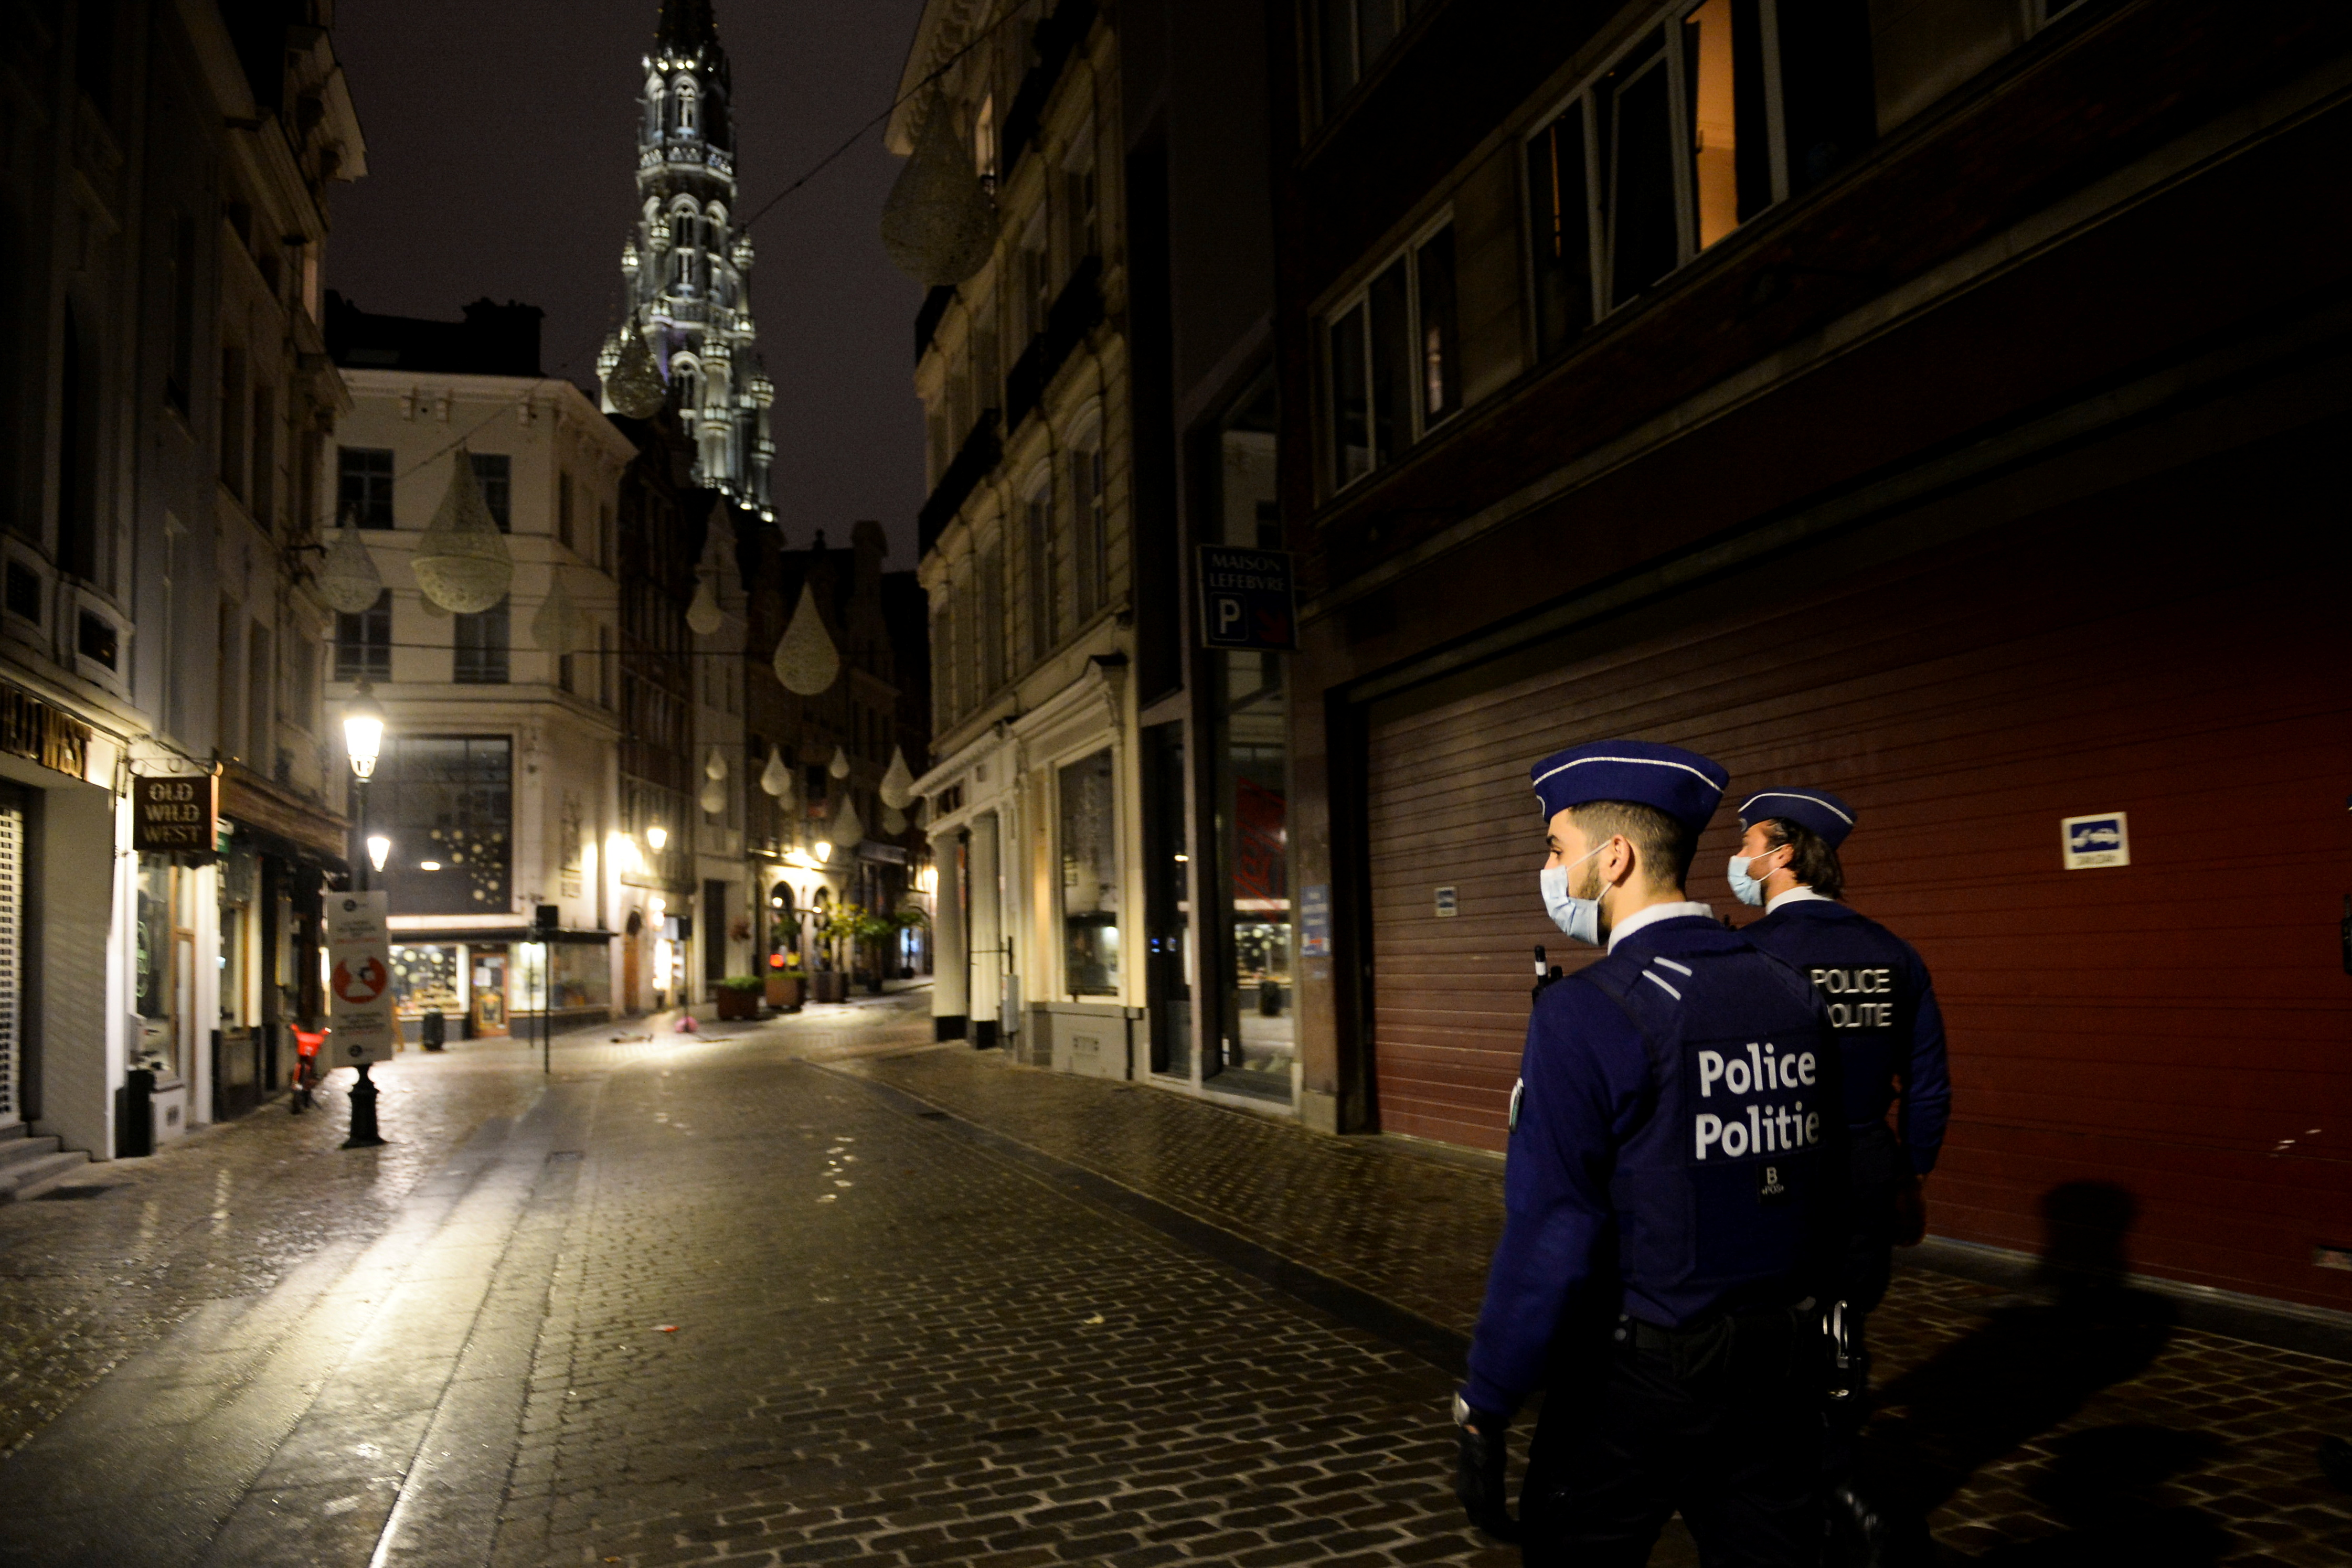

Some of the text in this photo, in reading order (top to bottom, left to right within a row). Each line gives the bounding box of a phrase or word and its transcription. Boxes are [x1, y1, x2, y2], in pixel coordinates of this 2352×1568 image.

[1211, 553, 1282, 571] MAISON
[1209, 572, 1285, 592] LEFEBVRE
[1218, 598, 1241, 634] P
[149, 782, 193, 802] OLD
[144, 804, 200, 822] WILD
[143, 825, 203, 842] WEST
[1811, 969, 1892, 994] POLICE
[1827, 1003, 1893, 1028] OLITIE
[1698, 1042, 1816, 1097] Police
[1696, 1101, 1819, 1160] Politie
[1766, 1166, 1778, 1185] B
